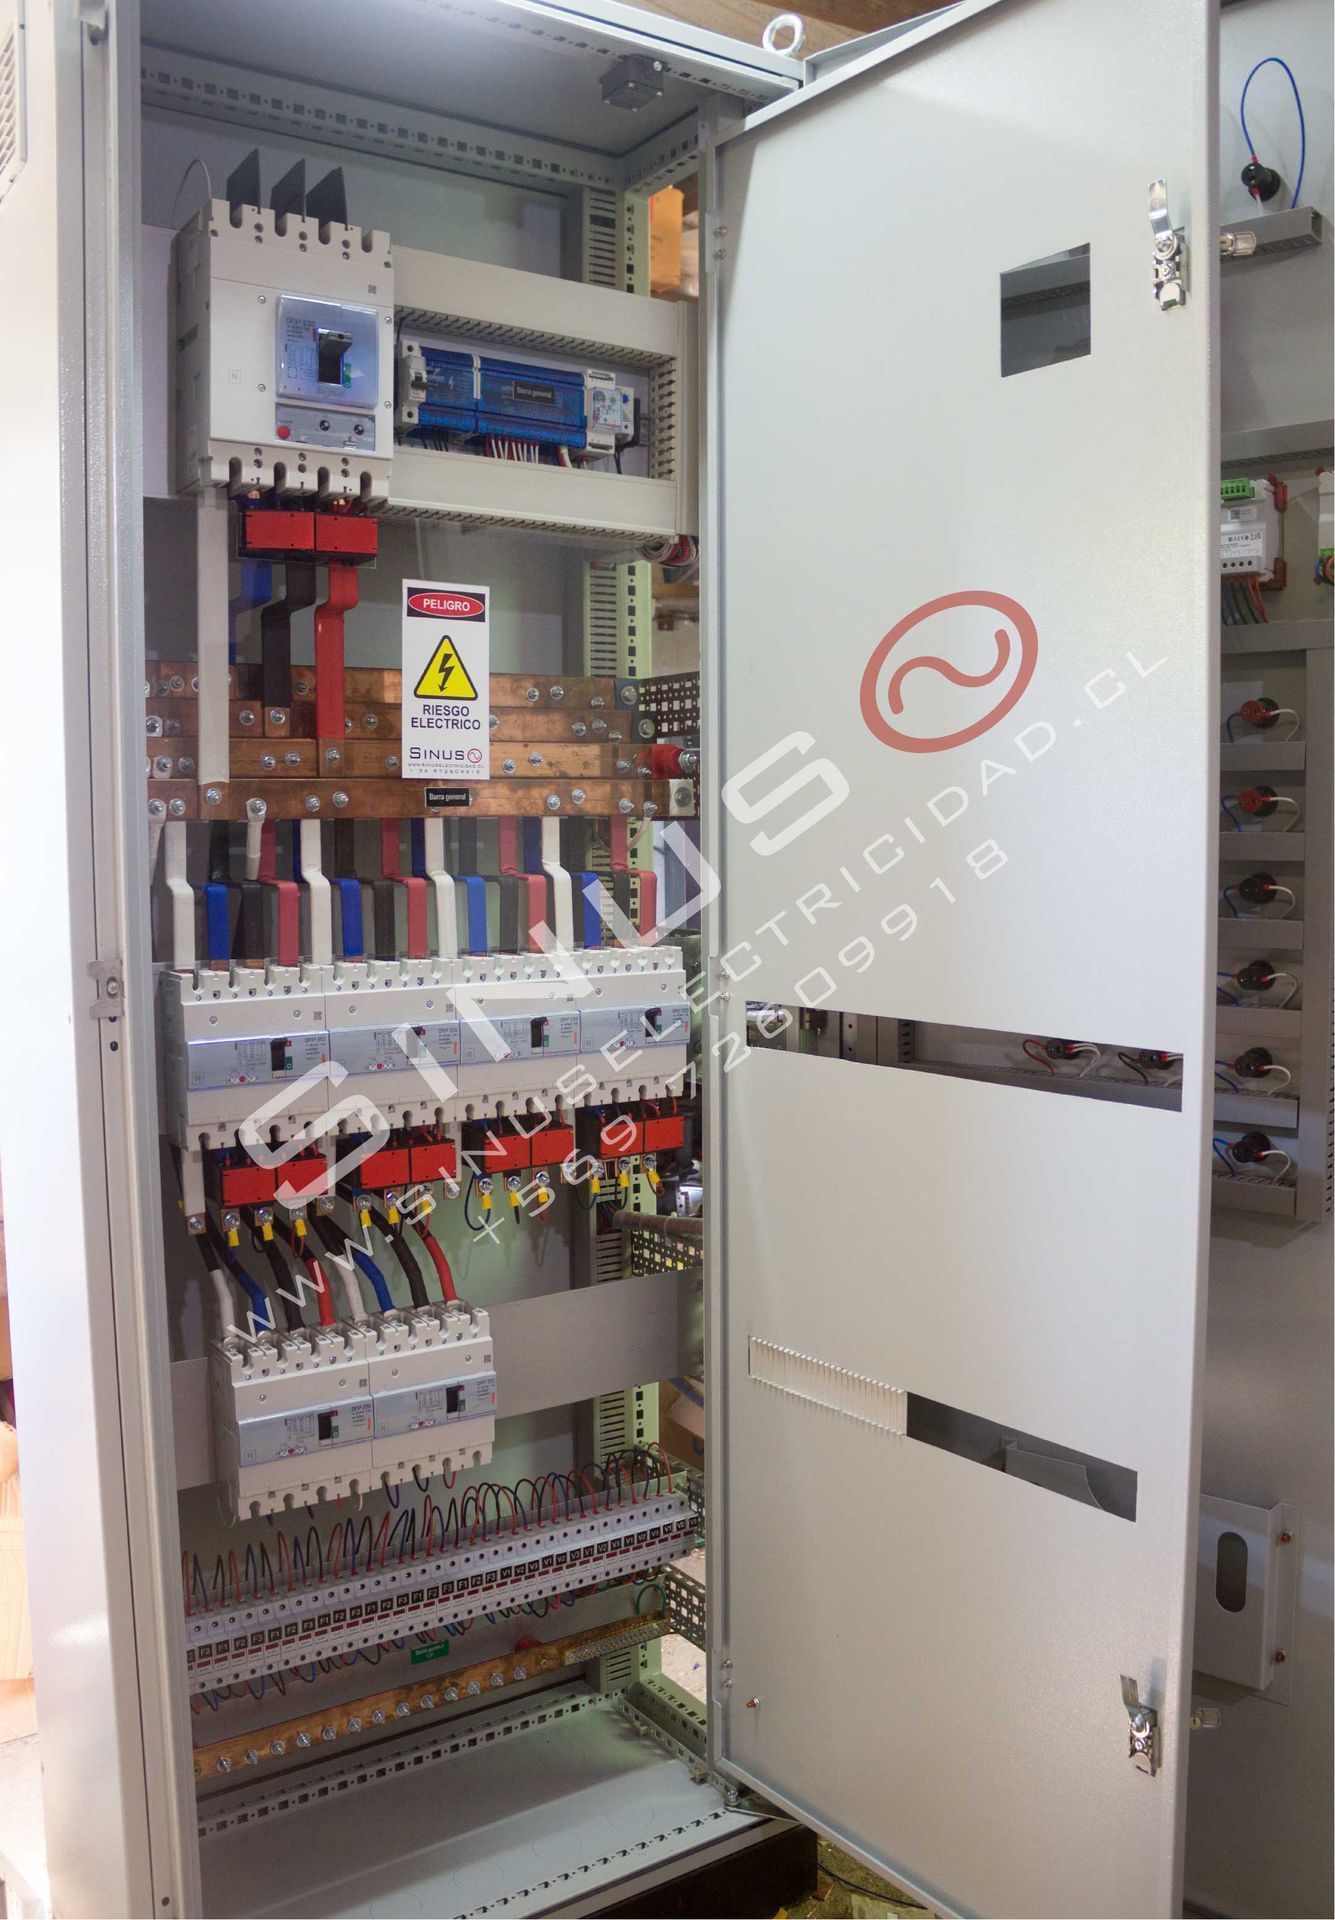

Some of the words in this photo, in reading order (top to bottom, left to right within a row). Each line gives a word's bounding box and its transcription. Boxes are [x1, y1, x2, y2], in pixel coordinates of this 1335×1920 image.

[423, 598, 471, 612] PELIGRO
[423, 704, 470, 717] RIESGO
[411, 717, 481, 730] ELECTRICO
[409, 747, 465, 761] SINUS
[429, 793, 444, 802] Barra
[445, 793, 467, 803] general
[236, 1640, 246, 1648] F2
[270, 1631, 280, 1640] F1
[288, 1626, 297, 1634] F2
[304, 1621, 313, 1629] F3
[320, 1617, 329, 1625] F1
[336, 1612, 344, 1620] F2
[352, 1608, 361, 1616] F3
[383, 1601, 391, 1609] F2
[414, 1593, 422, 1601] F1
[429, 1588, 437, 1597] F2
[444, 1584, 452, 1592] F3
[459, 1580, 467, 1588] F1
[472, 1576, 481, 1584] F2
[572, 1551, 580, 1559] V3
[599, 1544, 607, 1552] V2
[612, 1540, 620, 1548] V3
[638, 1533, 646, 1541] V2
